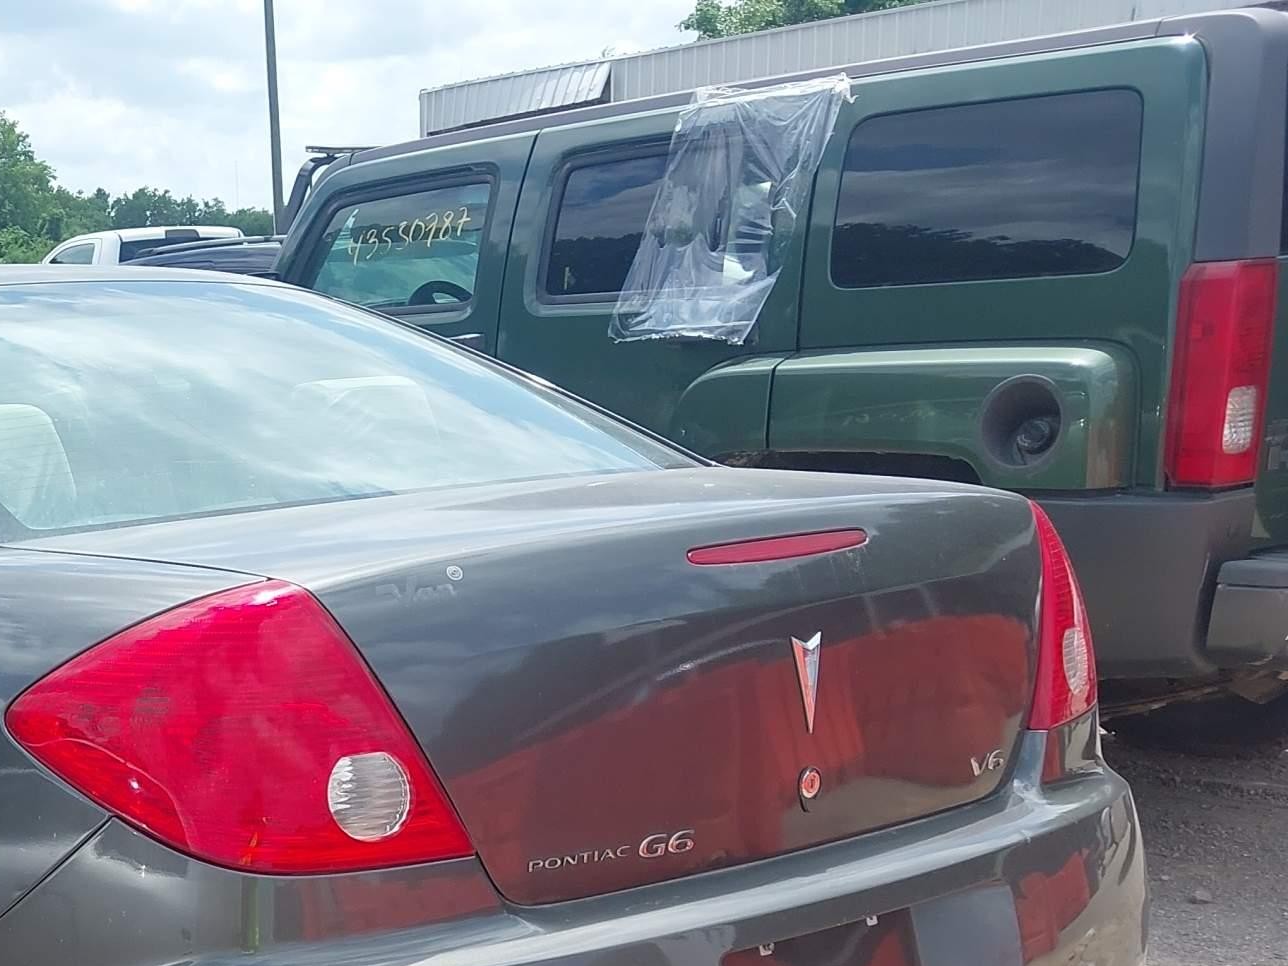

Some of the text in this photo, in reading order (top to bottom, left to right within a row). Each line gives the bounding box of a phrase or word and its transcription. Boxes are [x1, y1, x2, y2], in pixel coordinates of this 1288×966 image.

[970, 749, 1005, 777] V6
[527, 829, 696, 873] PONTIAC G6
